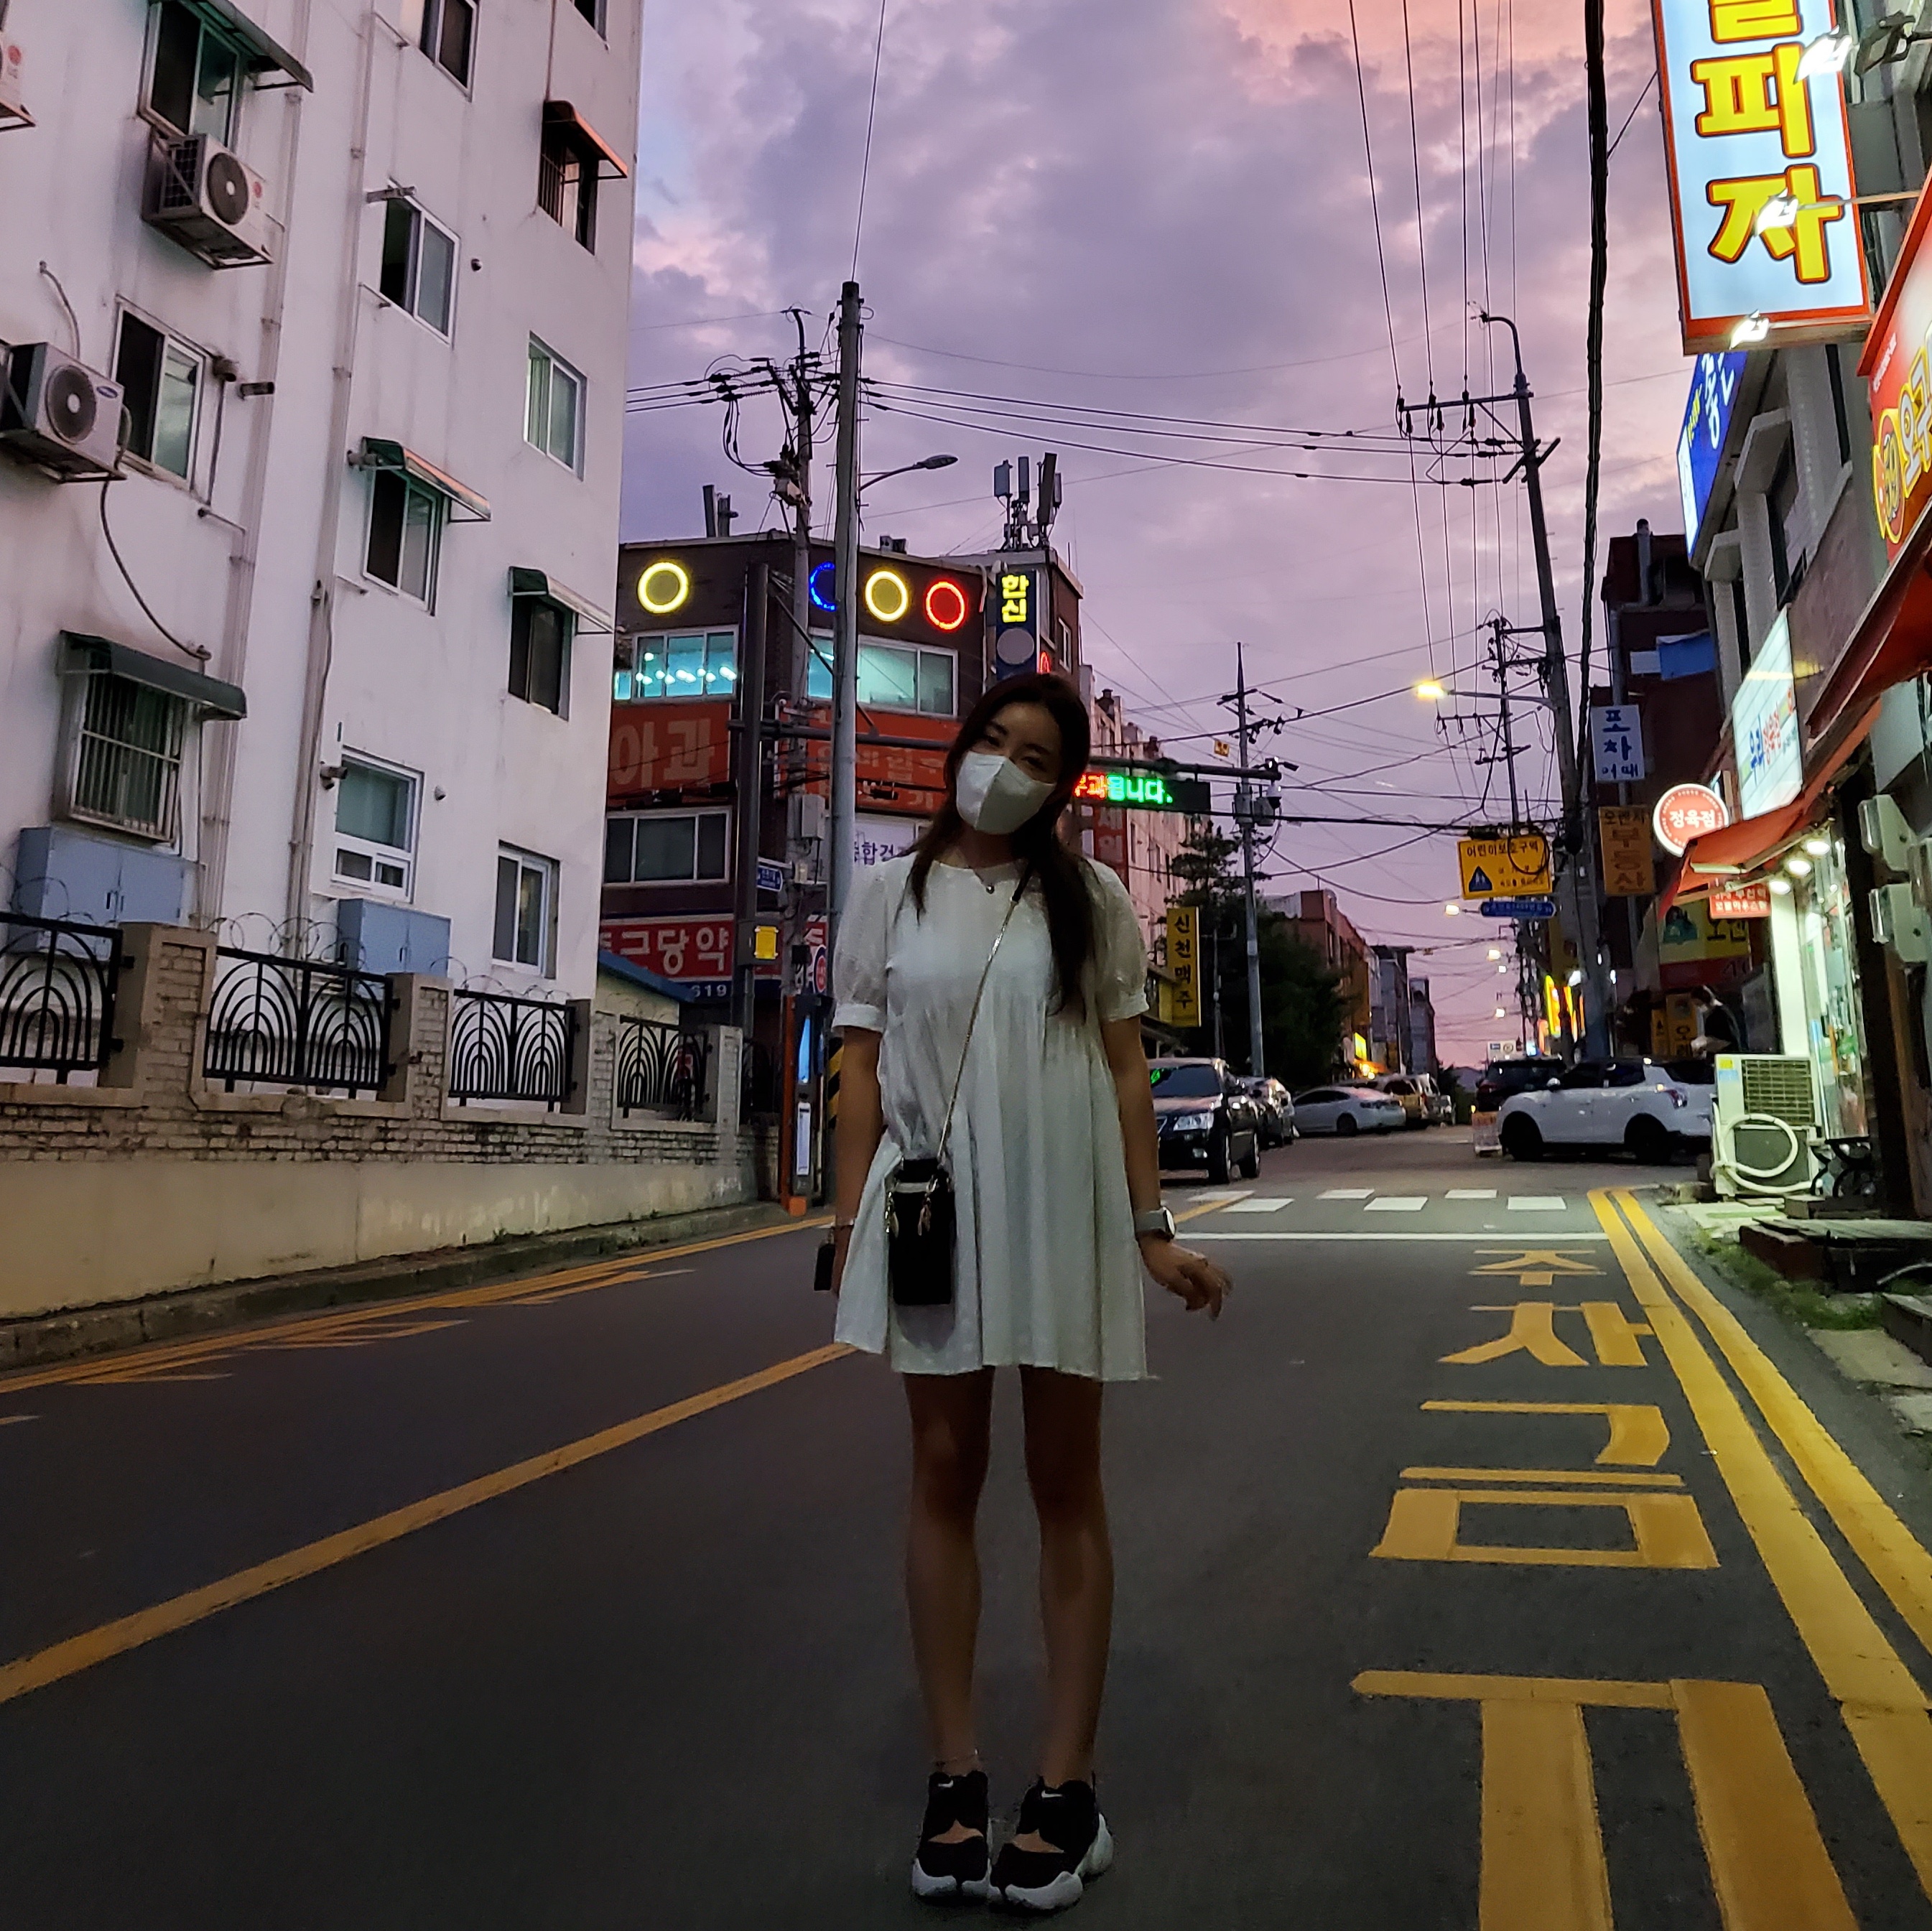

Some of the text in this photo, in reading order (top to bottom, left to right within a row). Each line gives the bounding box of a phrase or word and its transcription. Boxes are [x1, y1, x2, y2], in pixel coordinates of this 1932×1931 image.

[1001, 574, 1029, 623] 한신
[1602, 709, 1632, 760] 포차
[1602, 763, 1639, 779] 어때
[1669, 809, 1715, 829] 정육점
[1174, 913, 1193, 1010] 신천맥주
